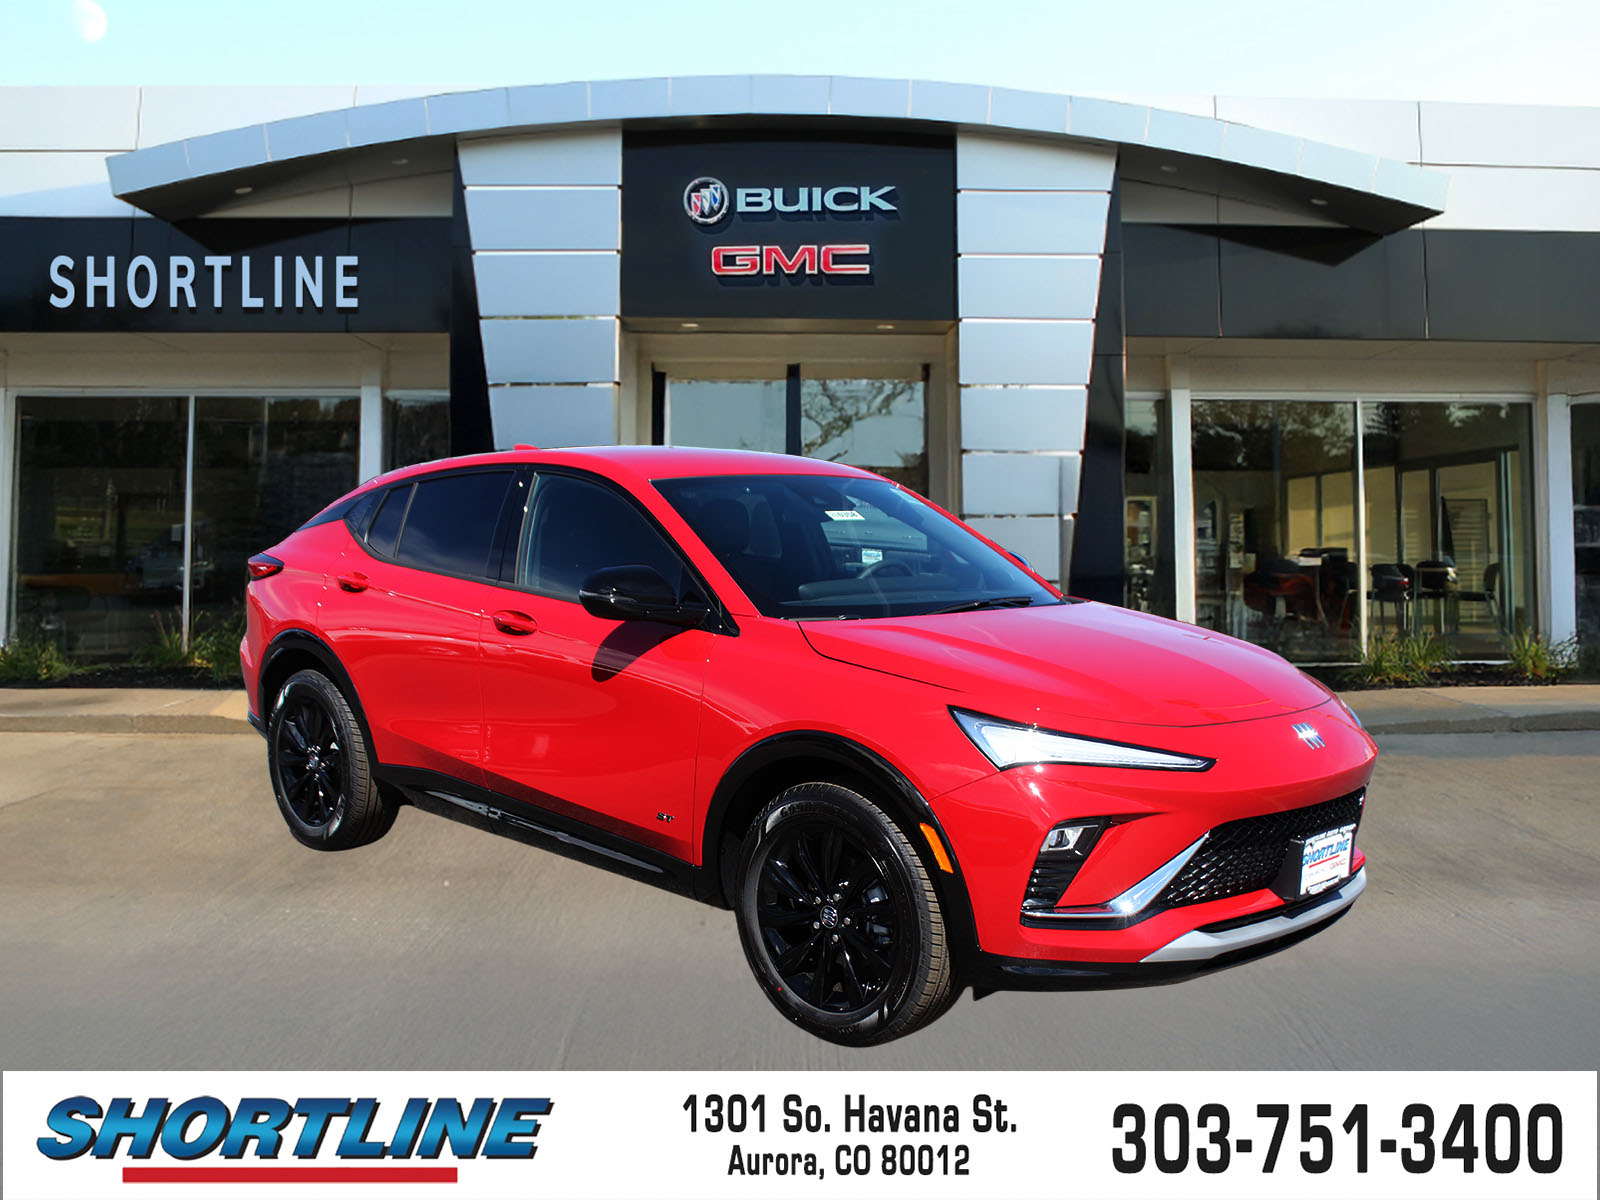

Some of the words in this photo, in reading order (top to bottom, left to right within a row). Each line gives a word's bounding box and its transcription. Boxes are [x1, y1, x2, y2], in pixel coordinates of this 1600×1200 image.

[737, 186, 898, 212] BUICK
[711, 244, 870, 275] GMC
[49, 256, 359, 308] SHORTLINE
[656, 812, 675, 823] ST
[1302, 839, 1350, 866] SHORTLINE
